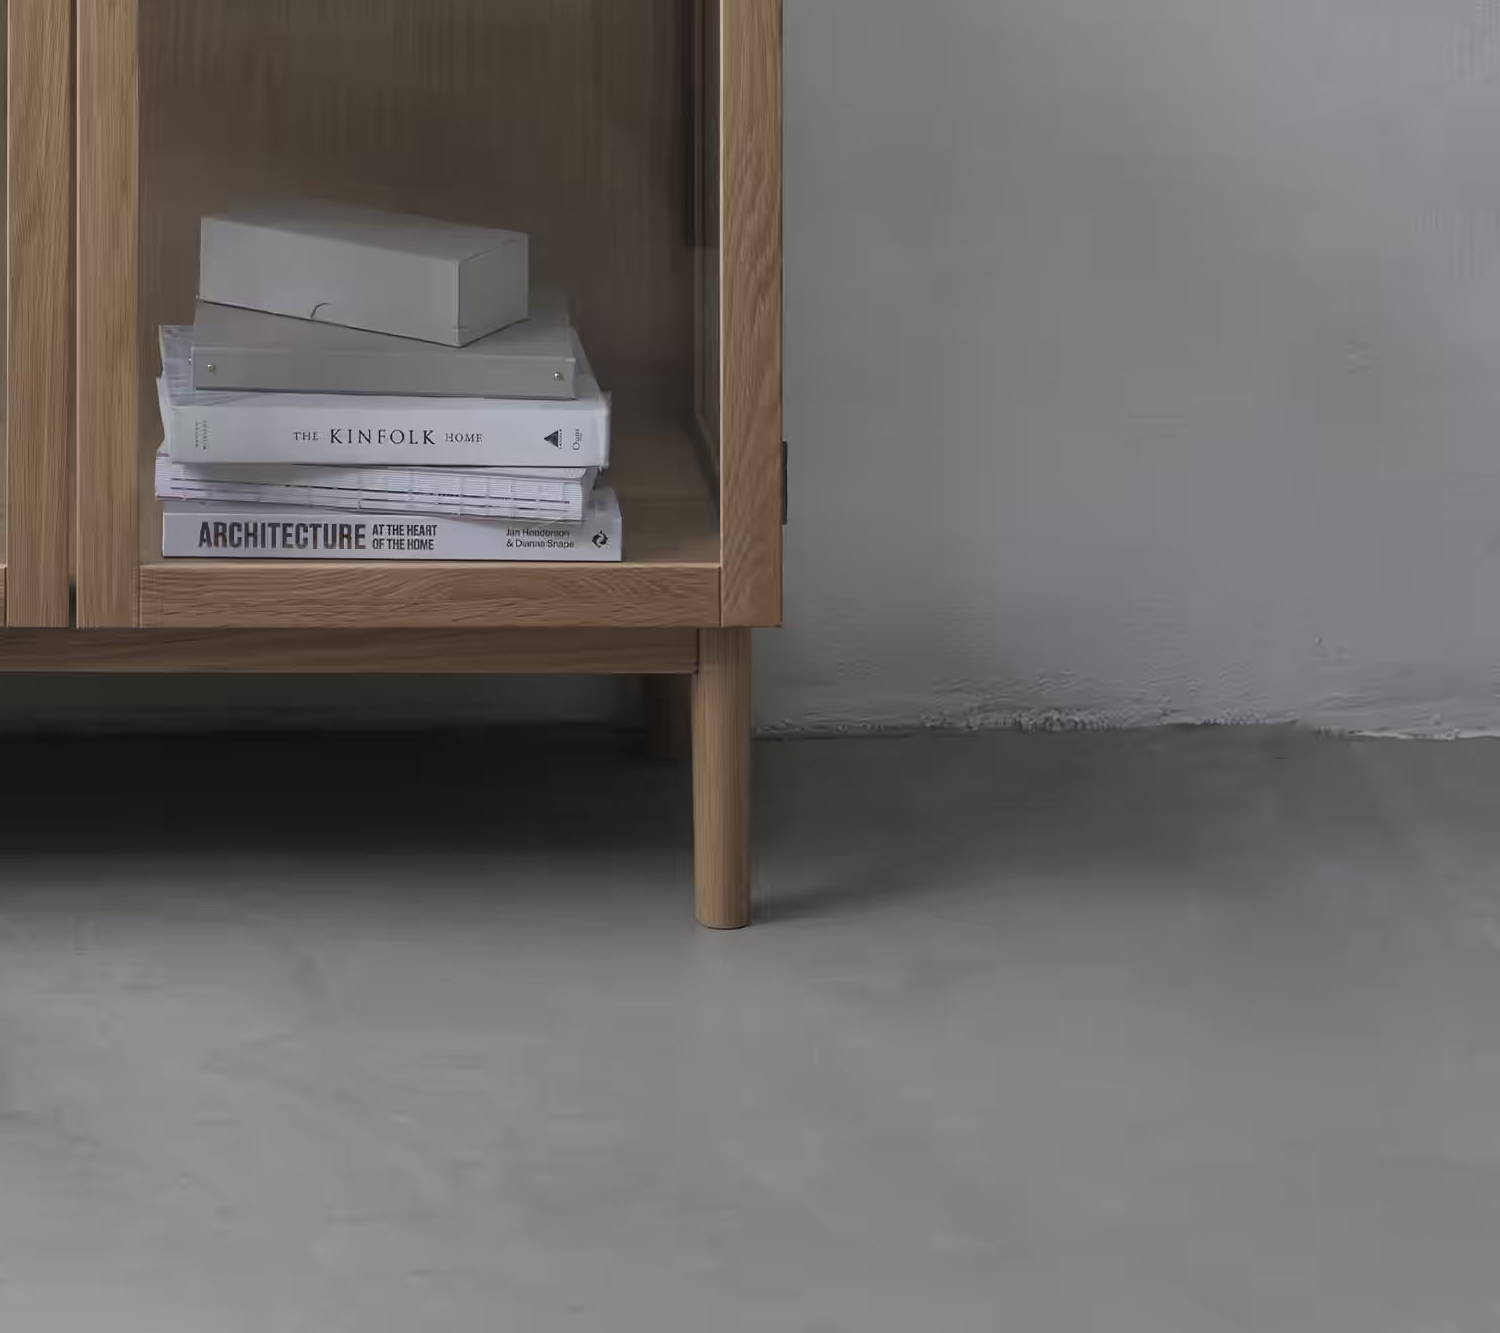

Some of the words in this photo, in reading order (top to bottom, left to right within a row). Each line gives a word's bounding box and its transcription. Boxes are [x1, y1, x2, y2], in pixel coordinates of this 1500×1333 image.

[293, 431, 319, 441] THE
[330, 429, 436, 445] KINFOLK
[445, 432, 483, 443] HOME
[198, 522, 367, 550] ARCHITECTURE
[372, 524, 385, 537] AT
[387, 524, 405, 537] THE
[407, 525, 438, 537] HEART
[372, 538, 385, 550] OF
[387, 538, 405, 550] THE
[407, 539, 434, 551] HOME
